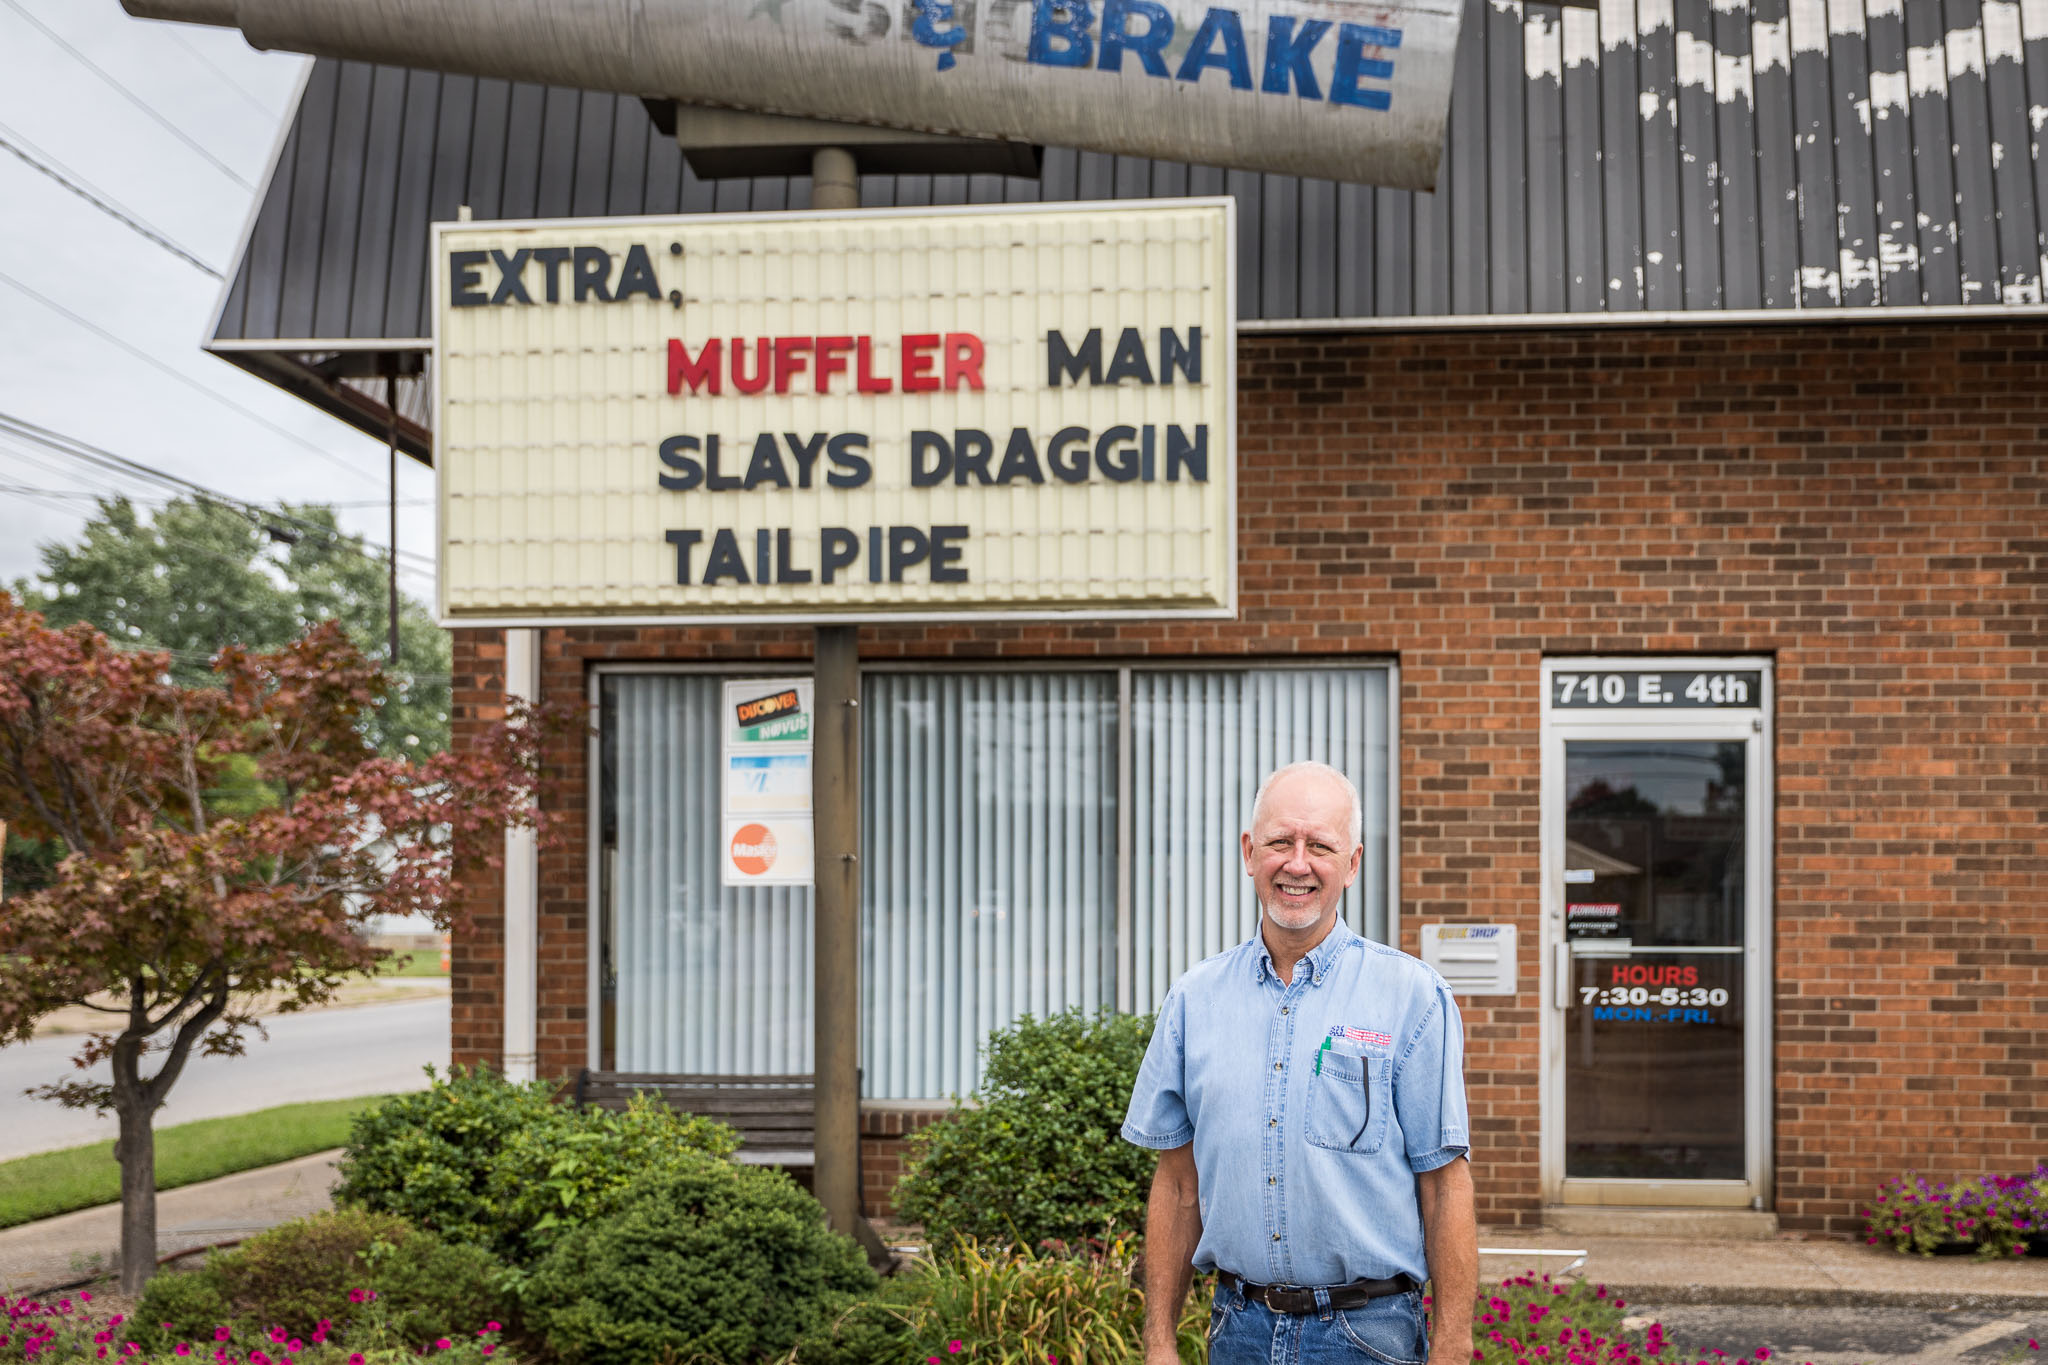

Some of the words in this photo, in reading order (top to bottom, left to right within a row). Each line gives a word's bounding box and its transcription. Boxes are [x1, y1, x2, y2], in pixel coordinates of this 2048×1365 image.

[1027, 0, 1402, 112] BRAKE
[667, 333, 986, 395] MUFFLER
[1047, 326, 1202, 387] MAN
[658, 432, 872, 491] SLAYS
[911, 424, 1208, 488] DRAGGIN
[665, 525, 970, 586] TAILPIPE
[1556, 673, 1626, 704] 710
[1638, 674, 1674, 703] E.
[1685, 673, 1748, 704] 4th
[1579, 986, 1729, 1007] 7:30-5:30
[1612, 965, 1699, 985] HOURS
